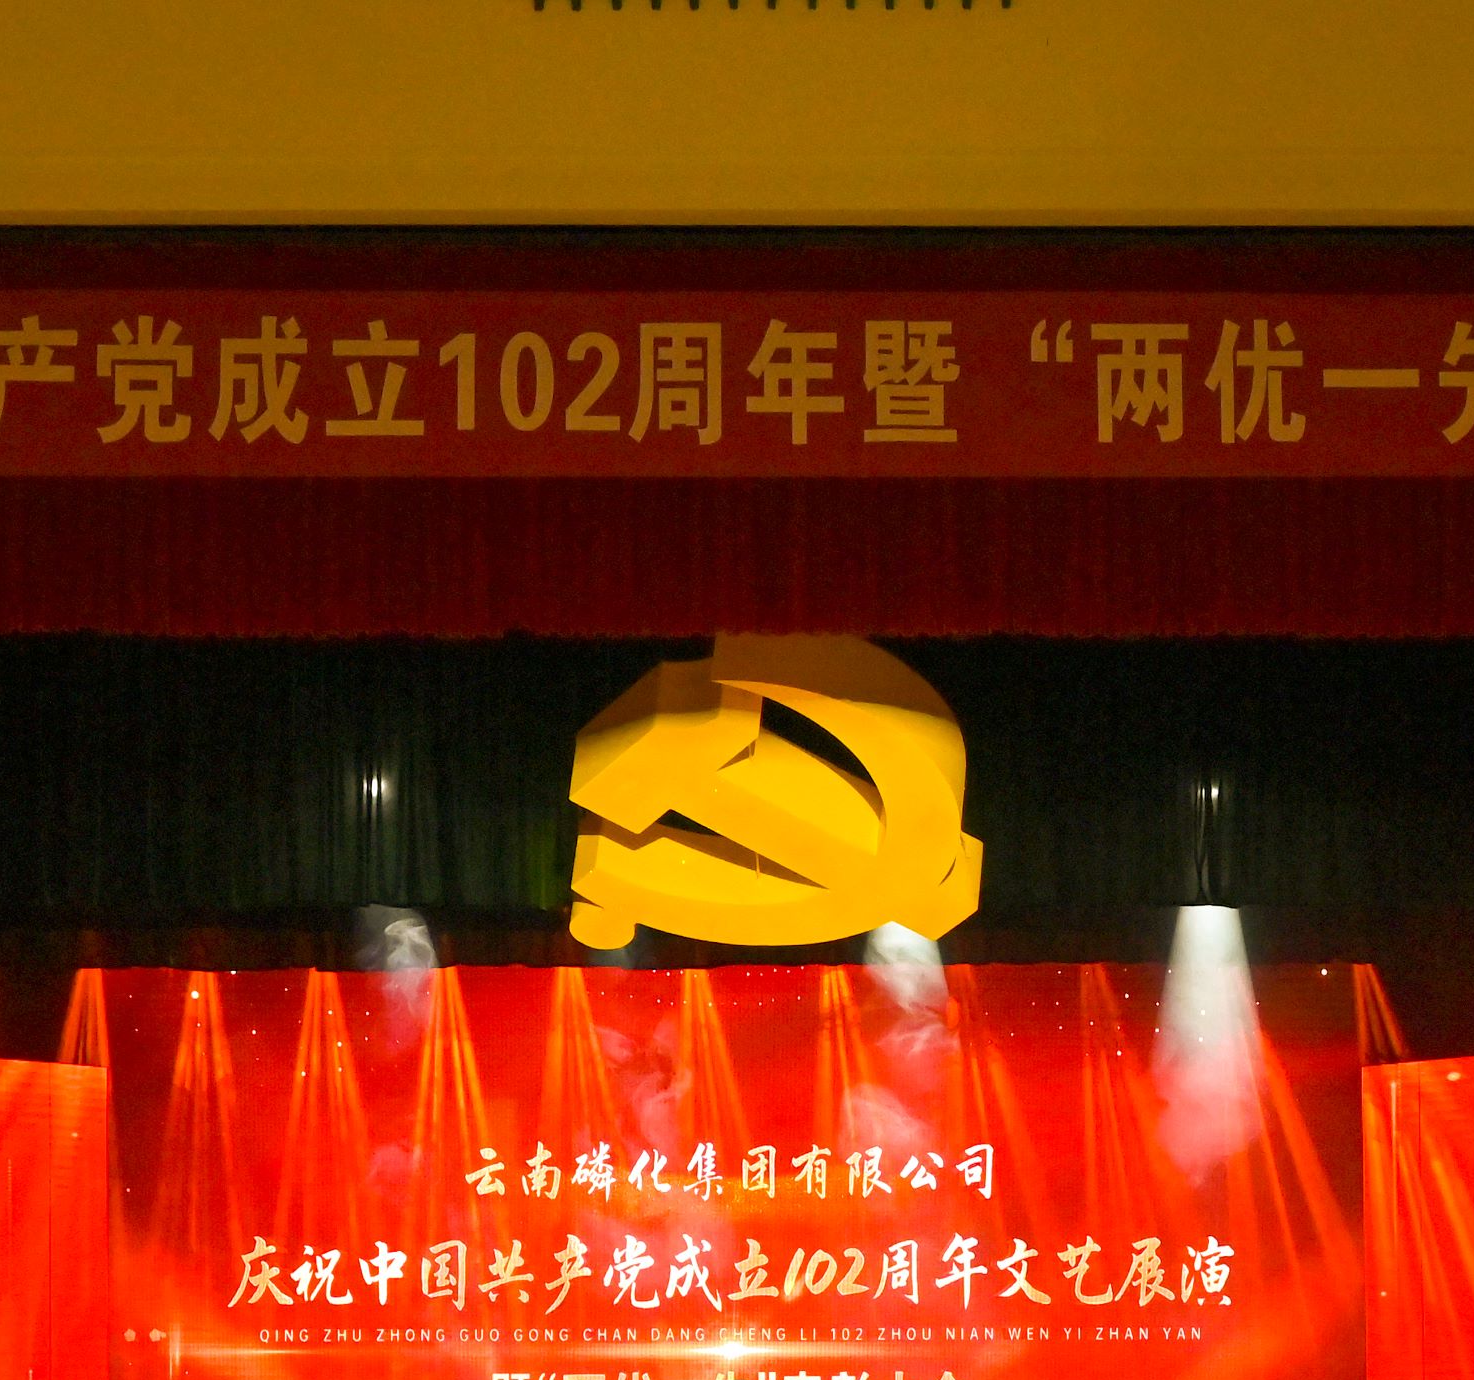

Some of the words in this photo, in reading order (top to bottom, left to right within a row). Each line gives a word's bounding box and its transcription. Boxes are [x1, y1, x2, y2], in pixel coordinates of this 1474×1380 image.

[464, 1142, 995, 1202] 云南磷化集团有限公司
[227, 1232, 1236, 1313] 庆祝中国共产党成立102周年文艺展演
[258, 1328, 310, 1343] QING
[323, 1328, 364, 1343] ZHU
[375, 1328, 447, 1343] ZHONG
[458, 1328, 501, 1343] GUO
[512, 1328, 571, 1342] GONG
[582, 1328, 638, 1342] CHAN
[650, 1328, 707, 1342] DANG
[799, 1327, 817, 1342] LI
[829, 1327, 865, 1342] 102
[877, 1327, 933, 1342] ZHOU
[944, 1327, 996, 1342] NIAN
[1007, 1327, 1051, 1341] WEN
[1062, 1327, 1083, 1341] YI
[1094, 1327, 1150, 1341] ZHAN
[1161, 1327, 1203, 1341] YAN
